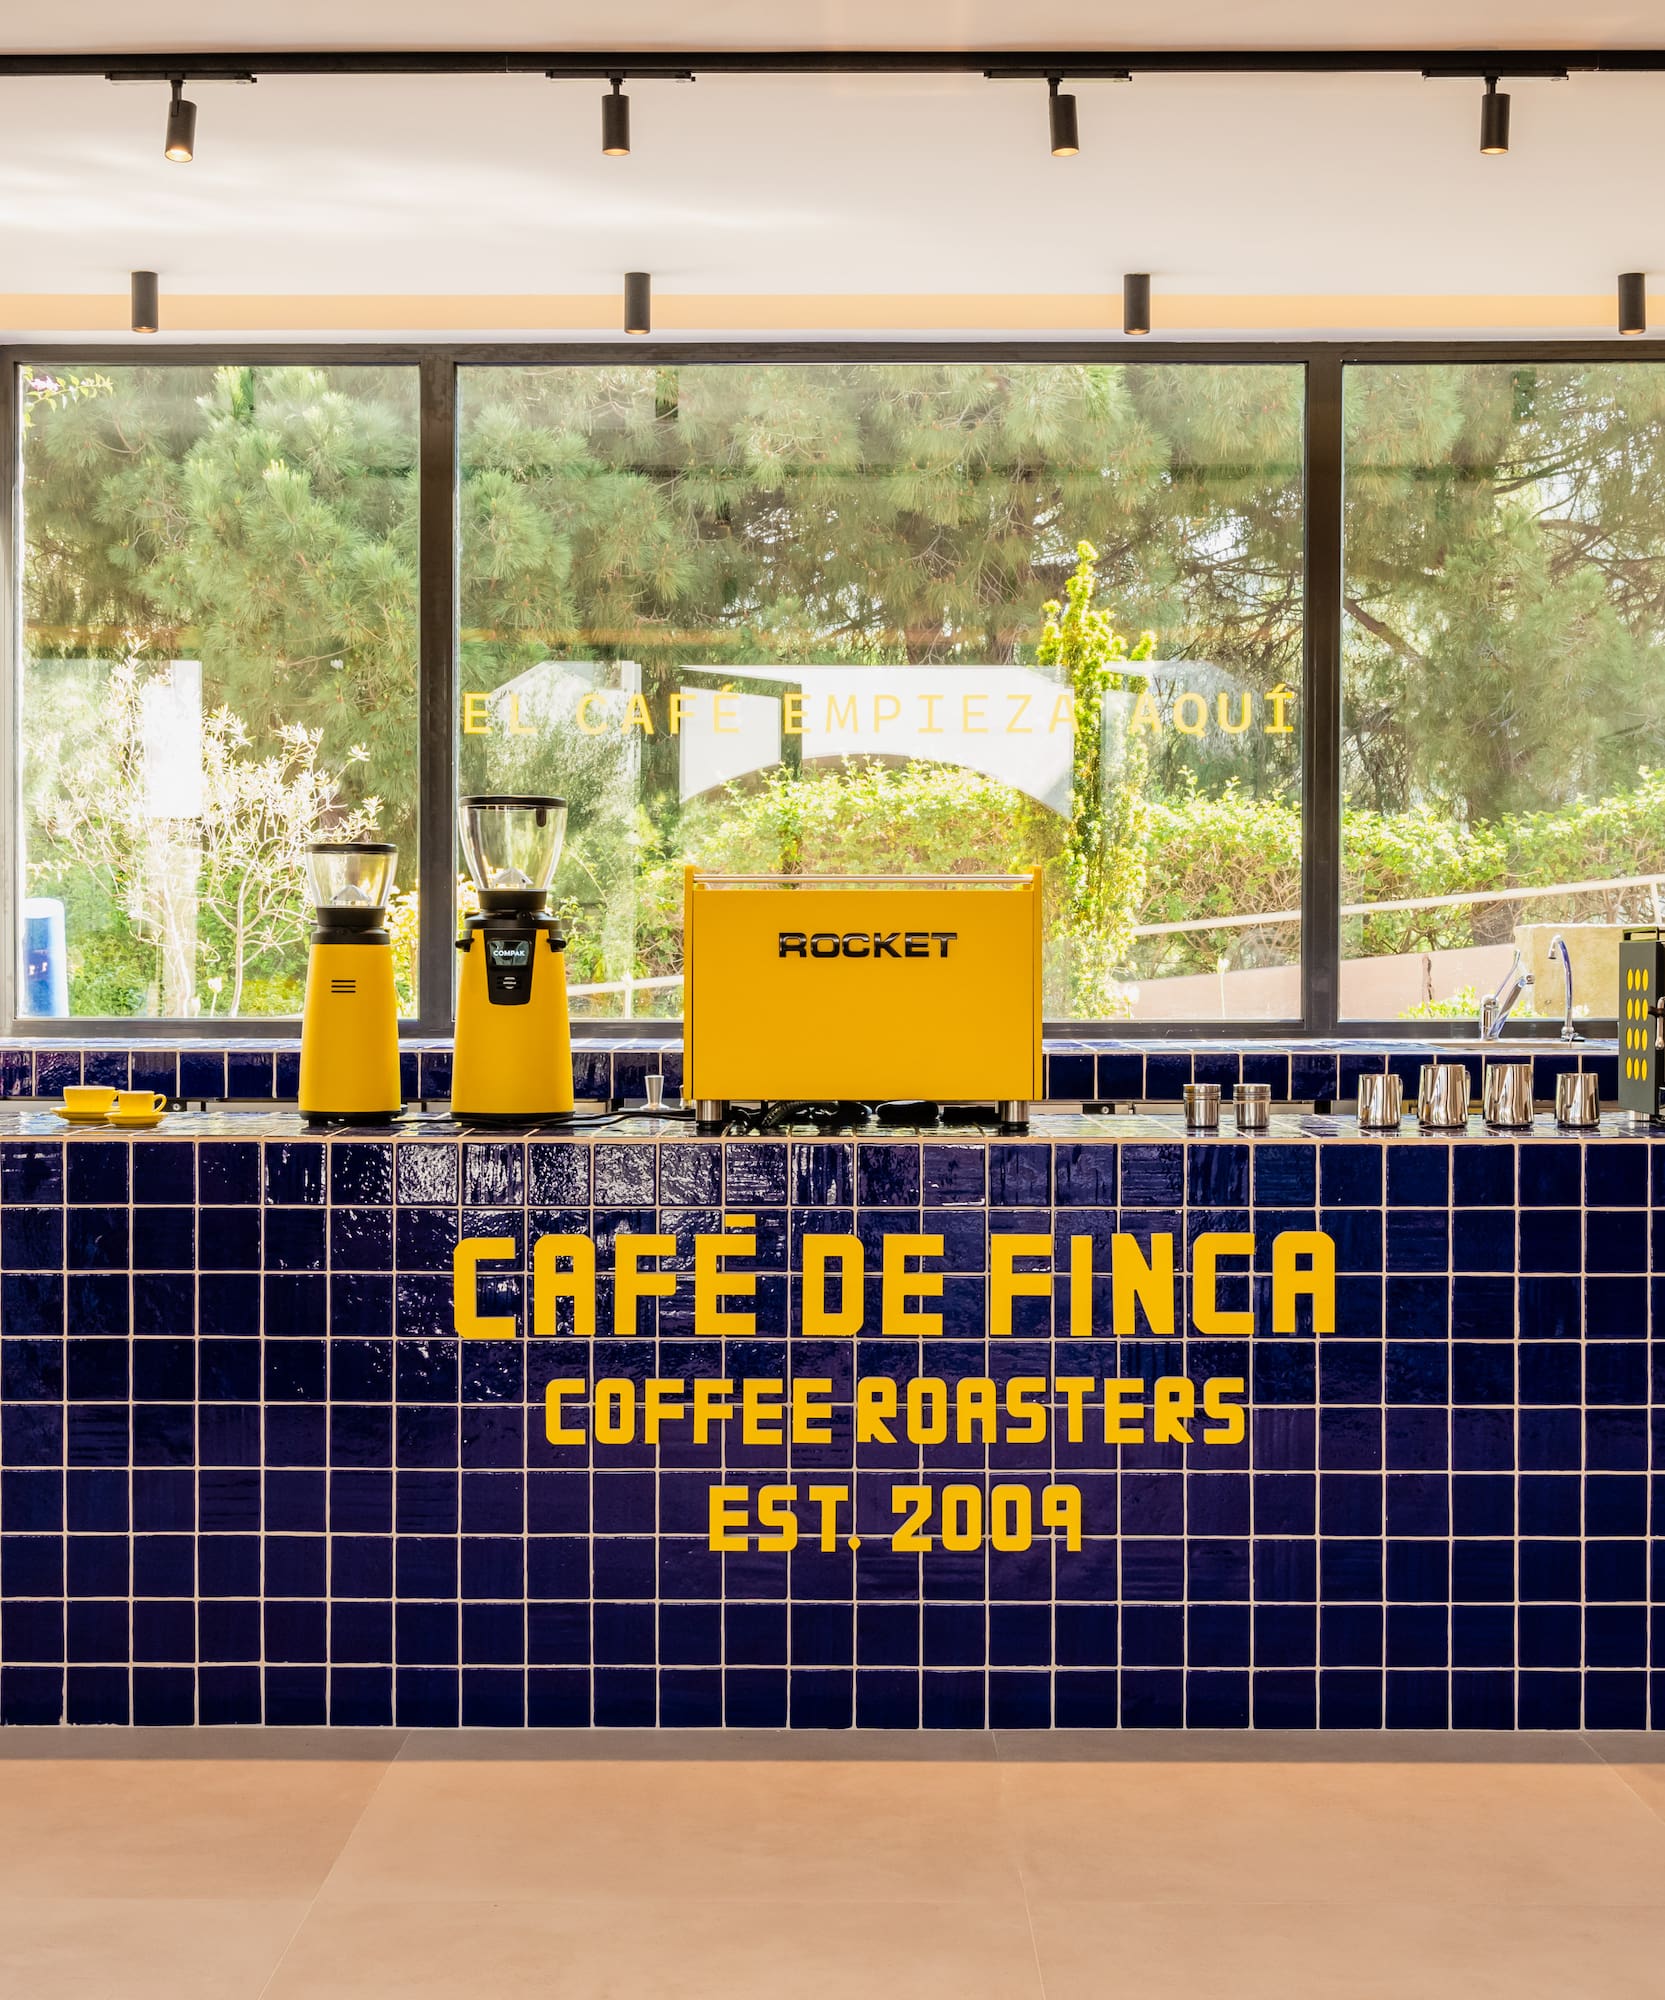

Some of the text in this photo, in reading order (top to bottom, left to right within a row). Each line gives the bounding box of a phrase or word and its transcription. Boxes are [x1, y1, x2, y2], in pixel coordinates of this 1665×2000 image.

[463, 683, 1294, 737] EL CAFÉ EMPIEZA AQUÍ
[778, 932, 958, 958] ROCKET
[802, 1234, 945, 1336] DE
[990, 1231, 1336, 1337] FINCA
[545, 1378, 1246, 1445] COFFEE ROASTERS
[709, 1485, 1083, 1553] EST. 2009
